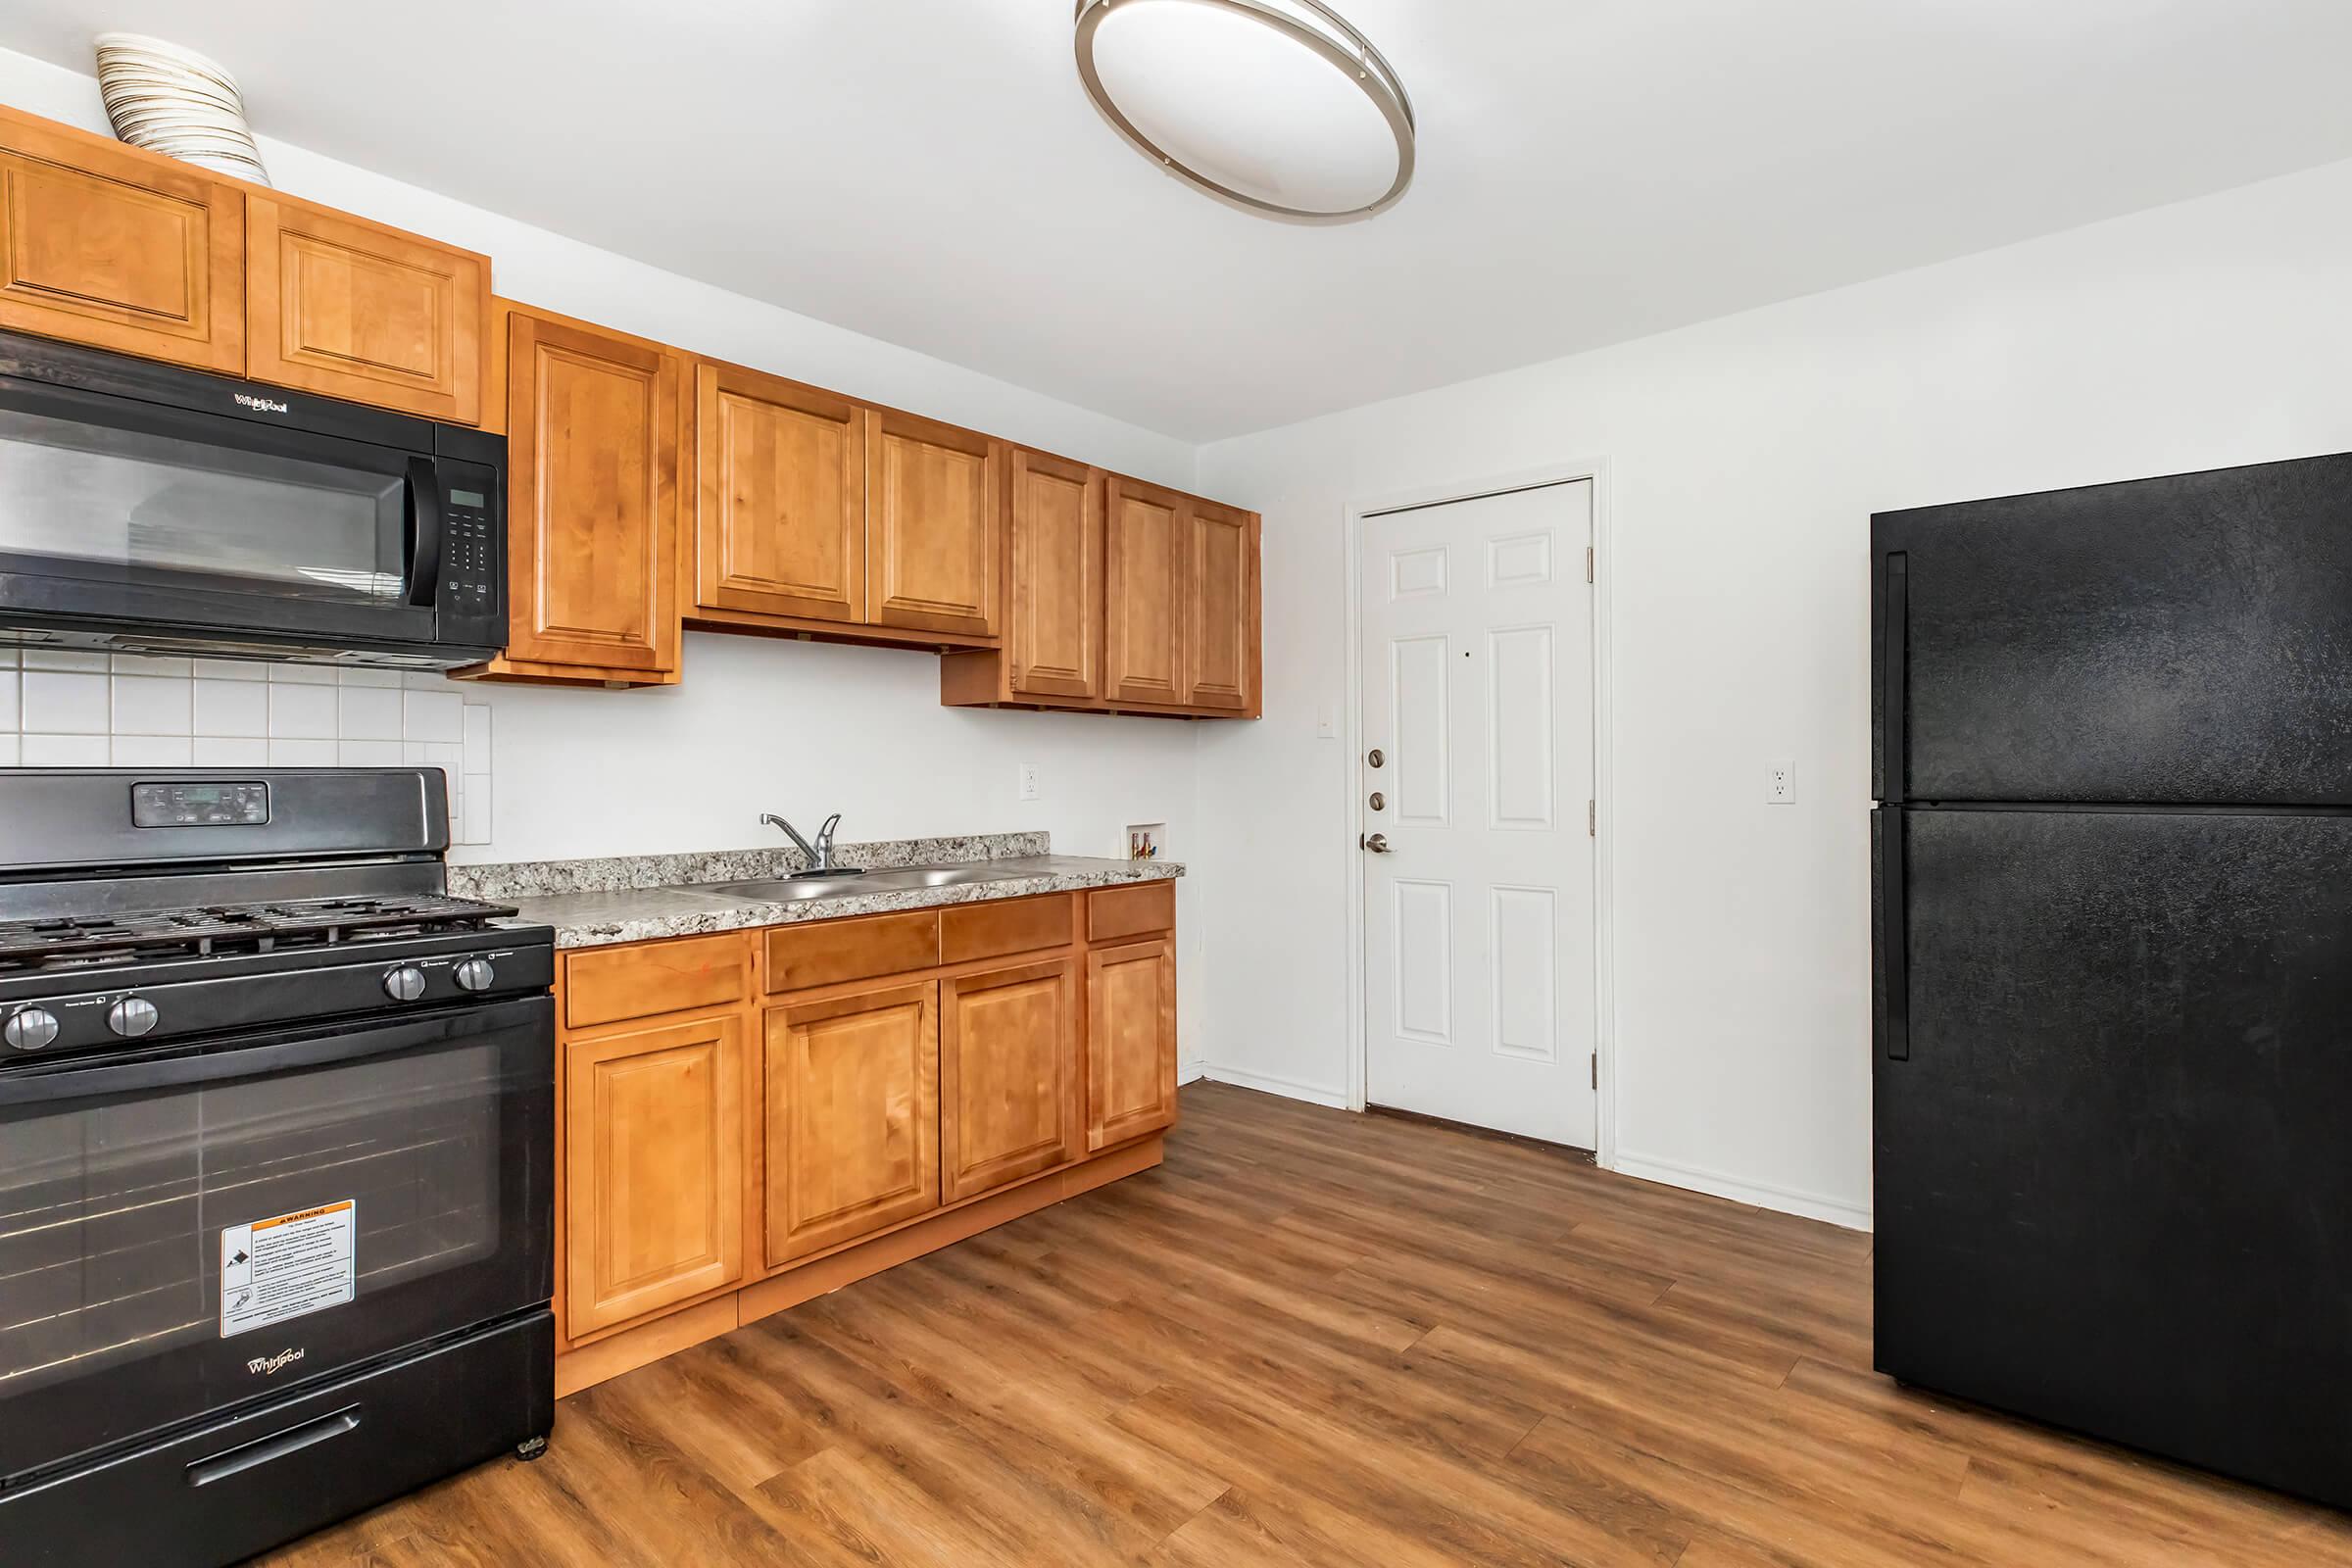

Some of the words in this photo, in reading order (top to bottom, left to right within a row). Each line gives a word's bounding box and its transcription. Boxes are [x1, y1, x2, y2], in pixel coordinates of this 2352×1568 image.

[234, 393, 288, 413] Whirlpool
[286, 1208, 325, 1222] WARNING
[247, 1348, 305, 1375] Whirlpool
